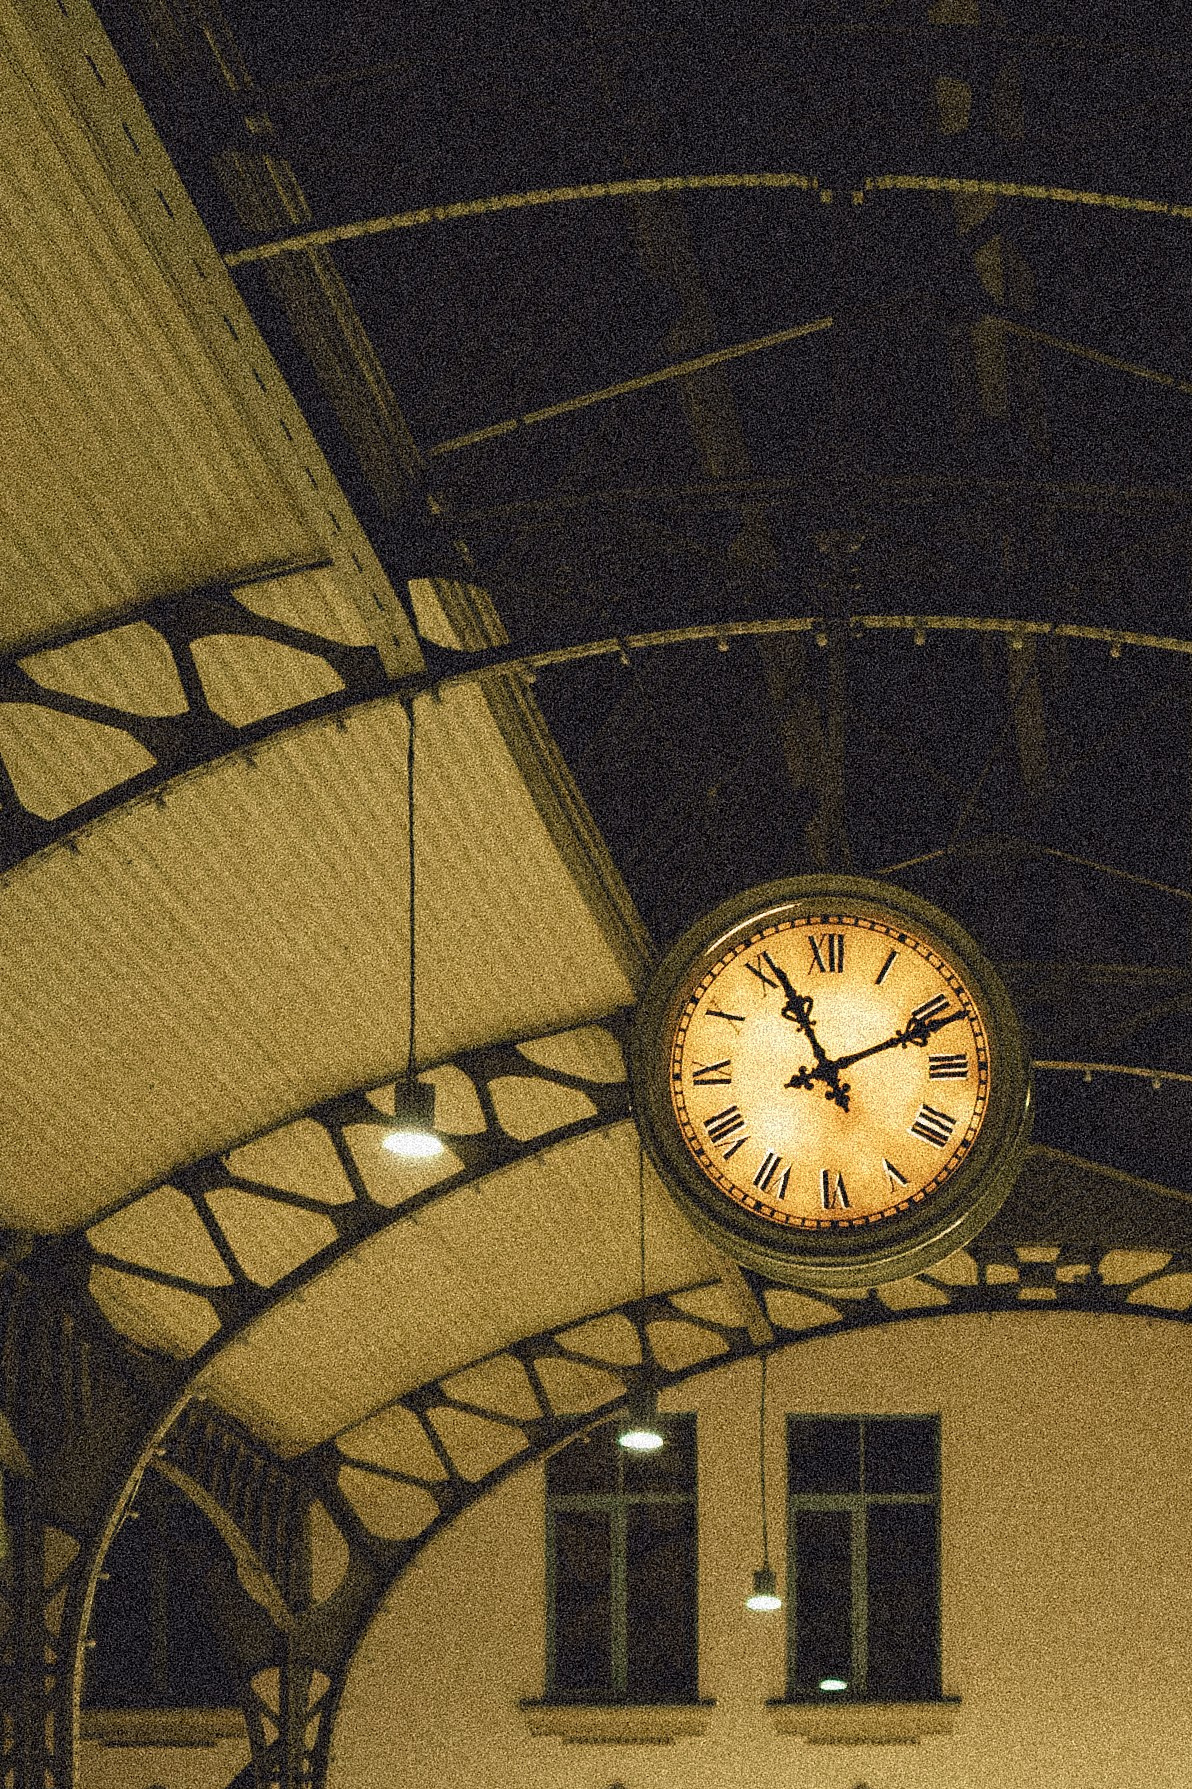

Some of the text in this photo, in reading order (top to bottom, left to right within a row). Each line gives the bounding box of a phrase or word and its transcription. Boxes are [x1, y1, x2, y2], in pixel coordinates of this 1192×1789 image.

[807, 933, 845, 975] XII
[875, 951, 898, 985] I
[705, 998, 746, 1034] X
[692, 1059, 732, 1085] IX
[928, 1053, 968, 1080] III
[703, 1104, 751, 1160] VIII
[907, 1102, 957, 1148] IIII
[752, 1150, 793, 1200] VII
[821, 1168, 852, 1210] VI
[881, 1158, 911, 1193] V
